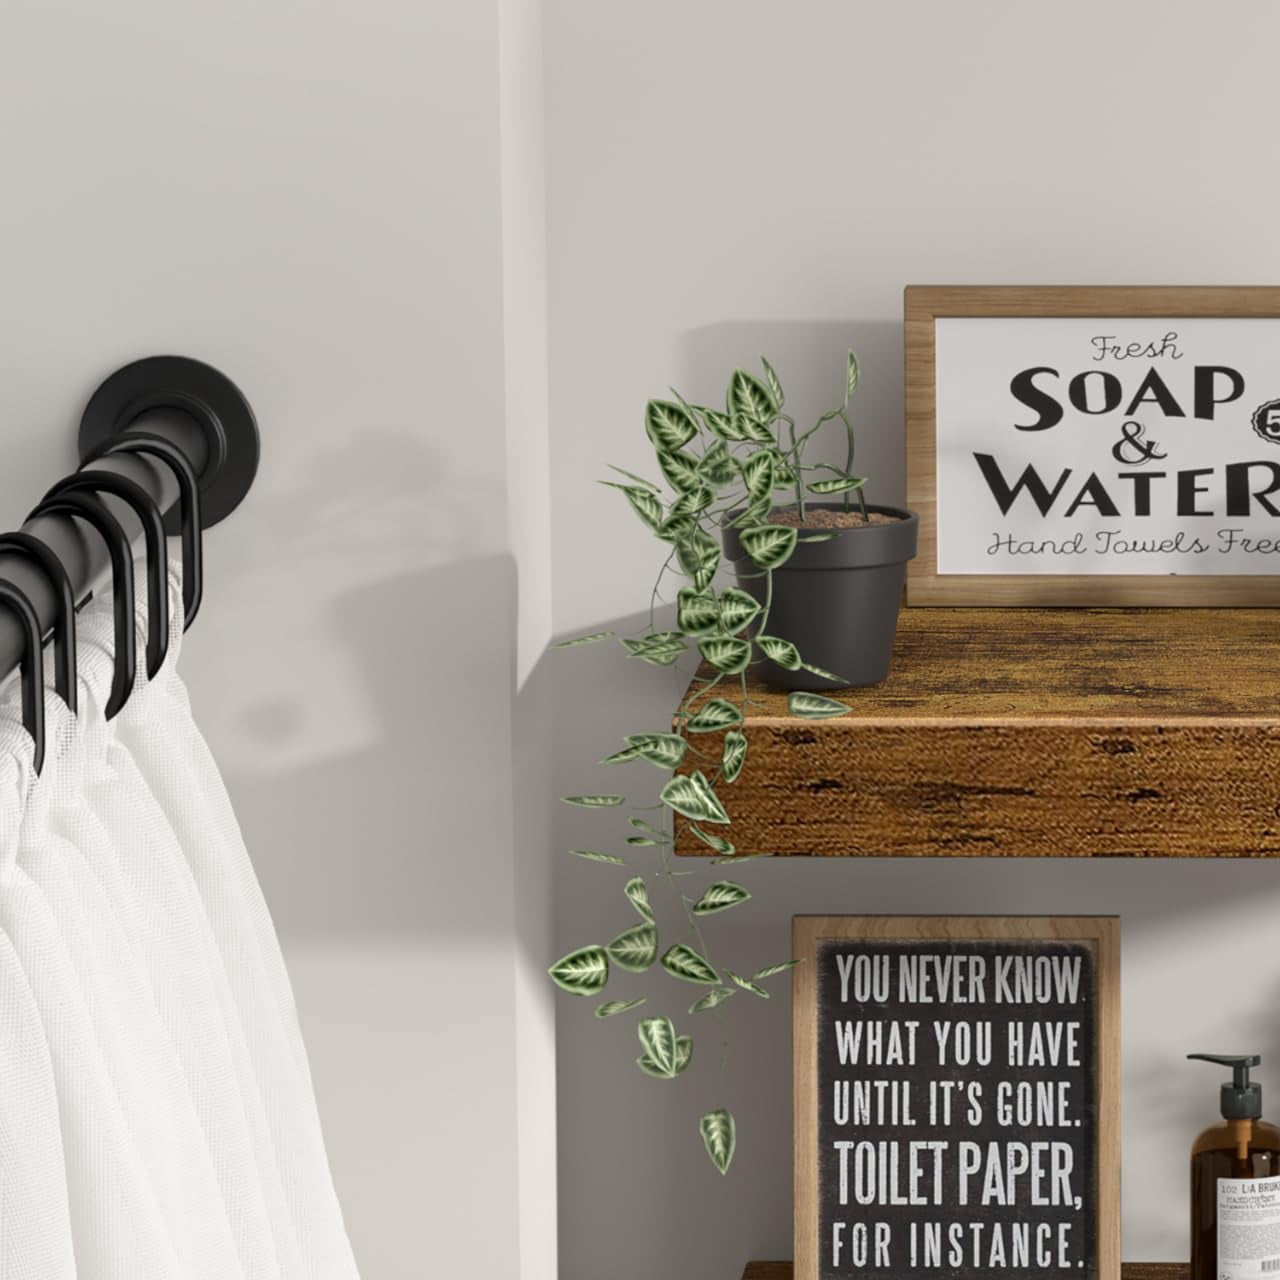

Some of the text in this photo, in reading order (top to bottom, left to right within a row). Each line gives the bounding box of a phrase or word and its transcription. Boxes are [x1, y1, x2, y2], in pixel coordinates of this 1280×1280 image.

[1091, 331, 1184, 361] Fresh
[1010, 366, 1245, 432] SOAP
[1112, 421, 1168, 466] &
[987, 532, 1087, 556] Hand
[1095, 531, 1211, 555] Towels
[836, 954, 1082, 1004] YOU NEVER KNOW
[835, 1020, 1081, 1067] WHAT YOU HAVE
[833, 1080, 1081, 1127] UNTIL IT'S GONE.
[833, 1140, 1083, 1210] TOILET PAPER,
[832, 1222, 1084, 1268] FOR INSTANCE.
